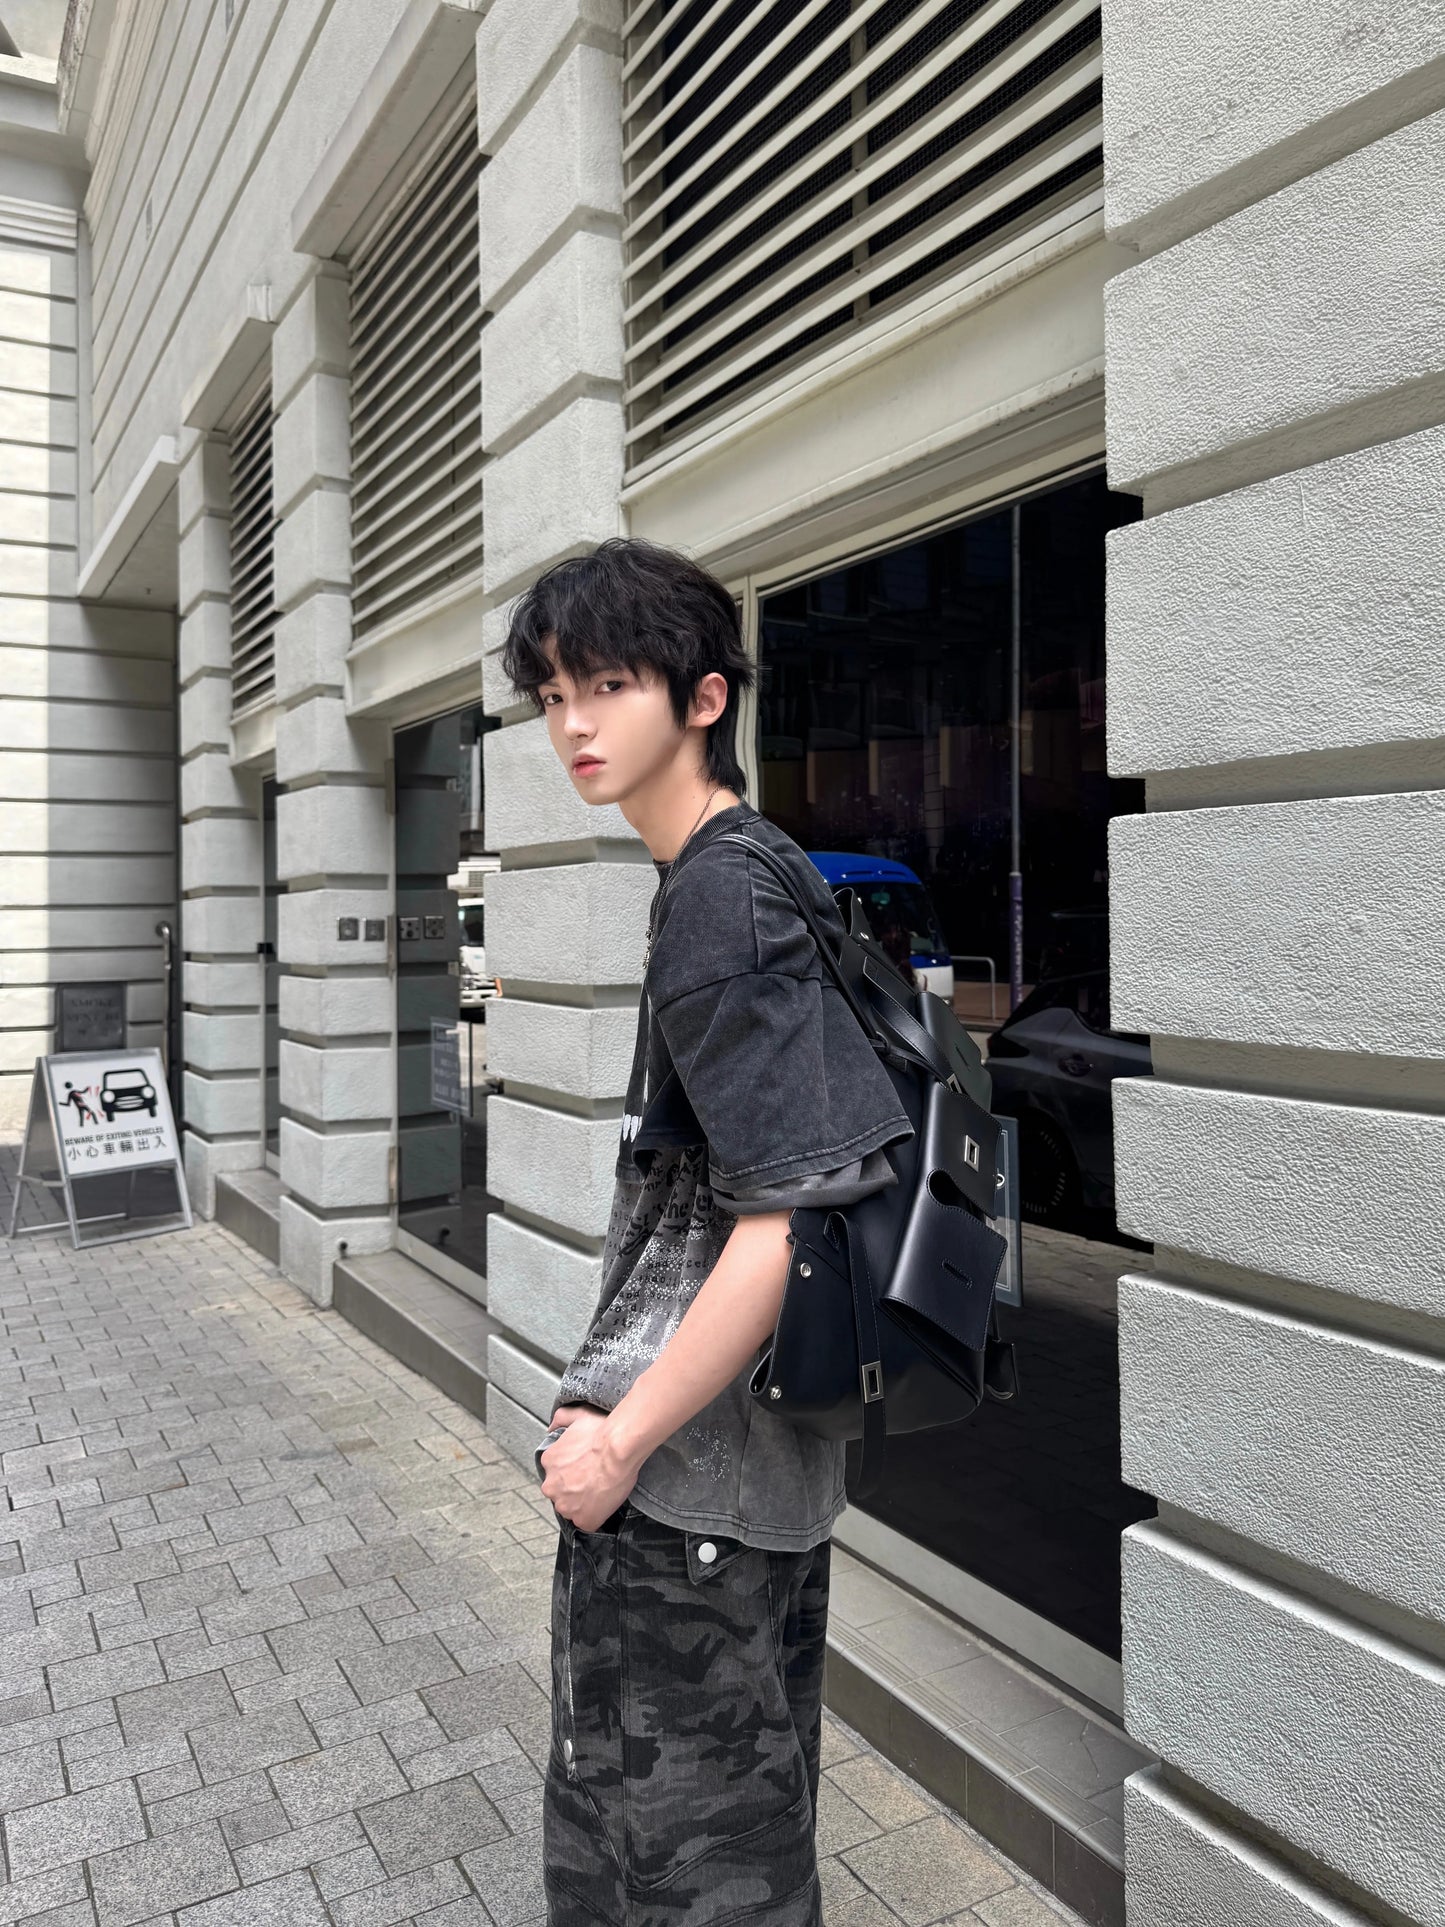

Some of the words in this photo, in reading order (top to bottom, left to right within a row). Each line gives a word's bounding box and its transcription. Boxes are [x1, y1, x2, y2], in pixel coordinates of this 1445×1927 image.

[64, 1135, 94, 1146] BEWARE
[95, 1134, 105, 1142] OF
[106, 1130, 132, 1140] EXITING
[133, 1127, 164, 1136] VEHICLES
